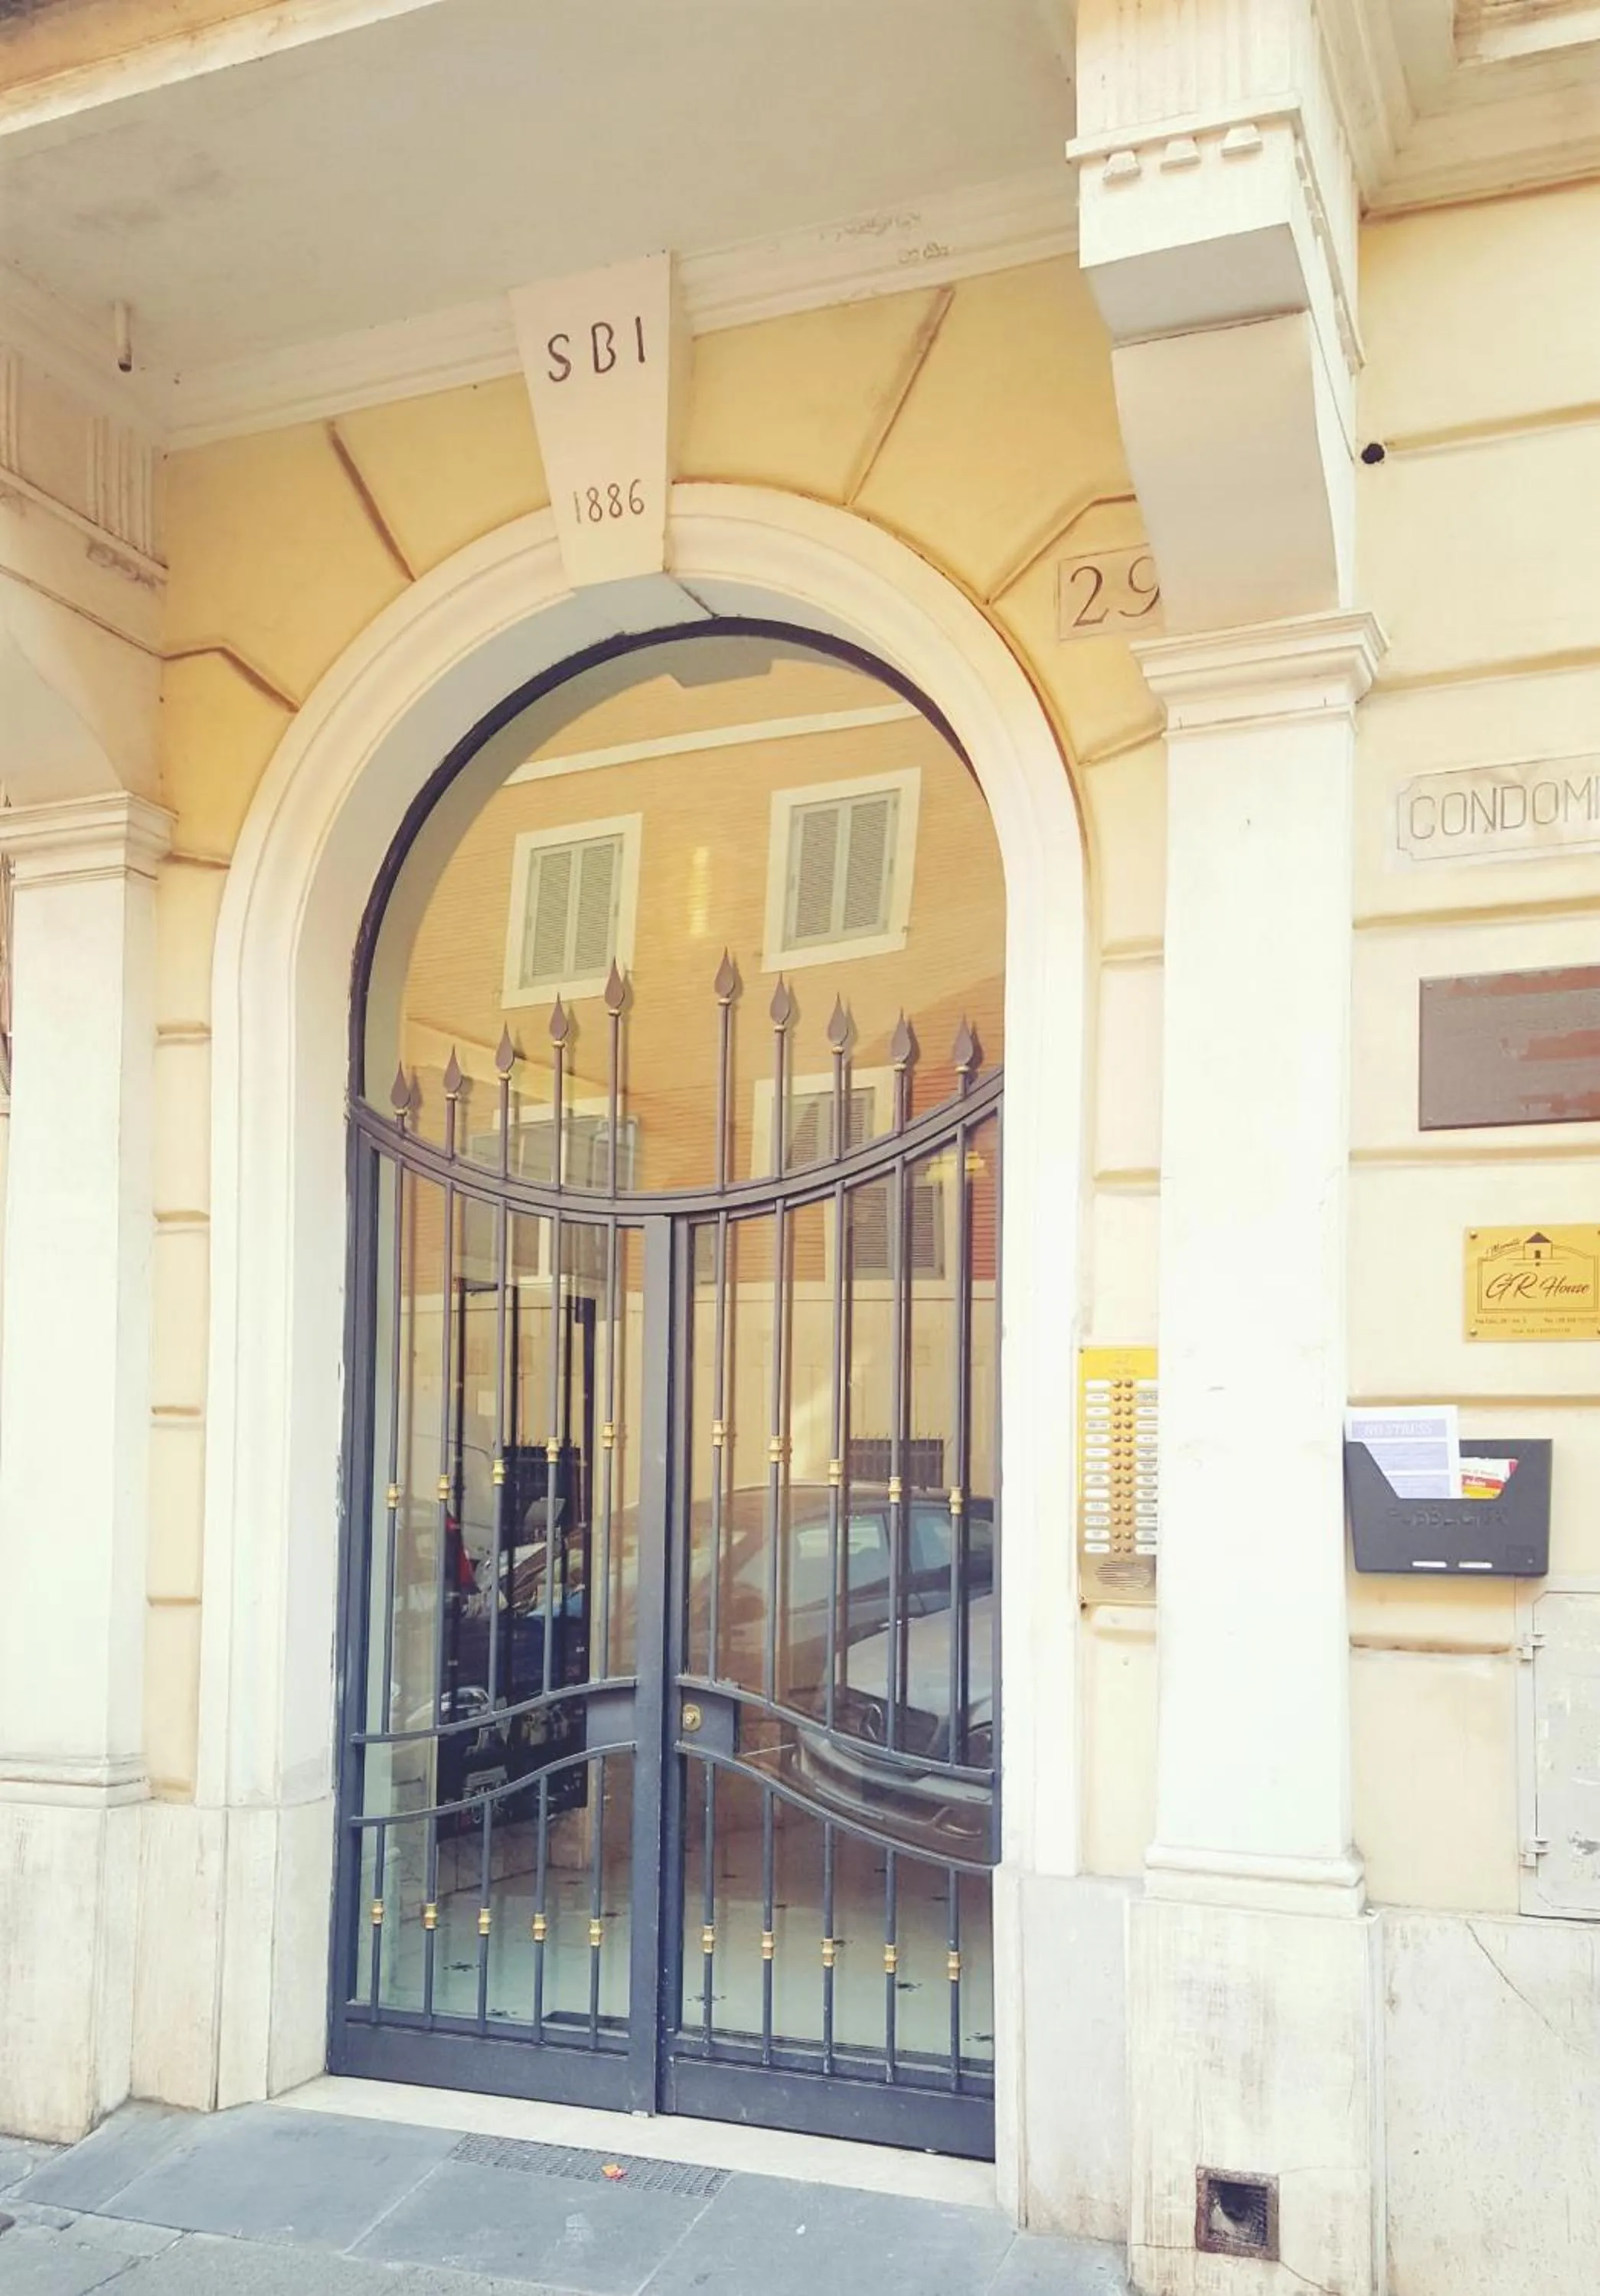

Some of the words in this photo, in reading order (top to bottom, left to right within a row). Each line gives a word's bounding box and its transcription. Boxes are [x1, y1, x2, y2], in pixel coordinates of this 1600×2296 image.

[574, 479, 645, 523] 1886
[1069, 556, 1160, 627] 29
[1540, 1275, 1590, 1299] House
